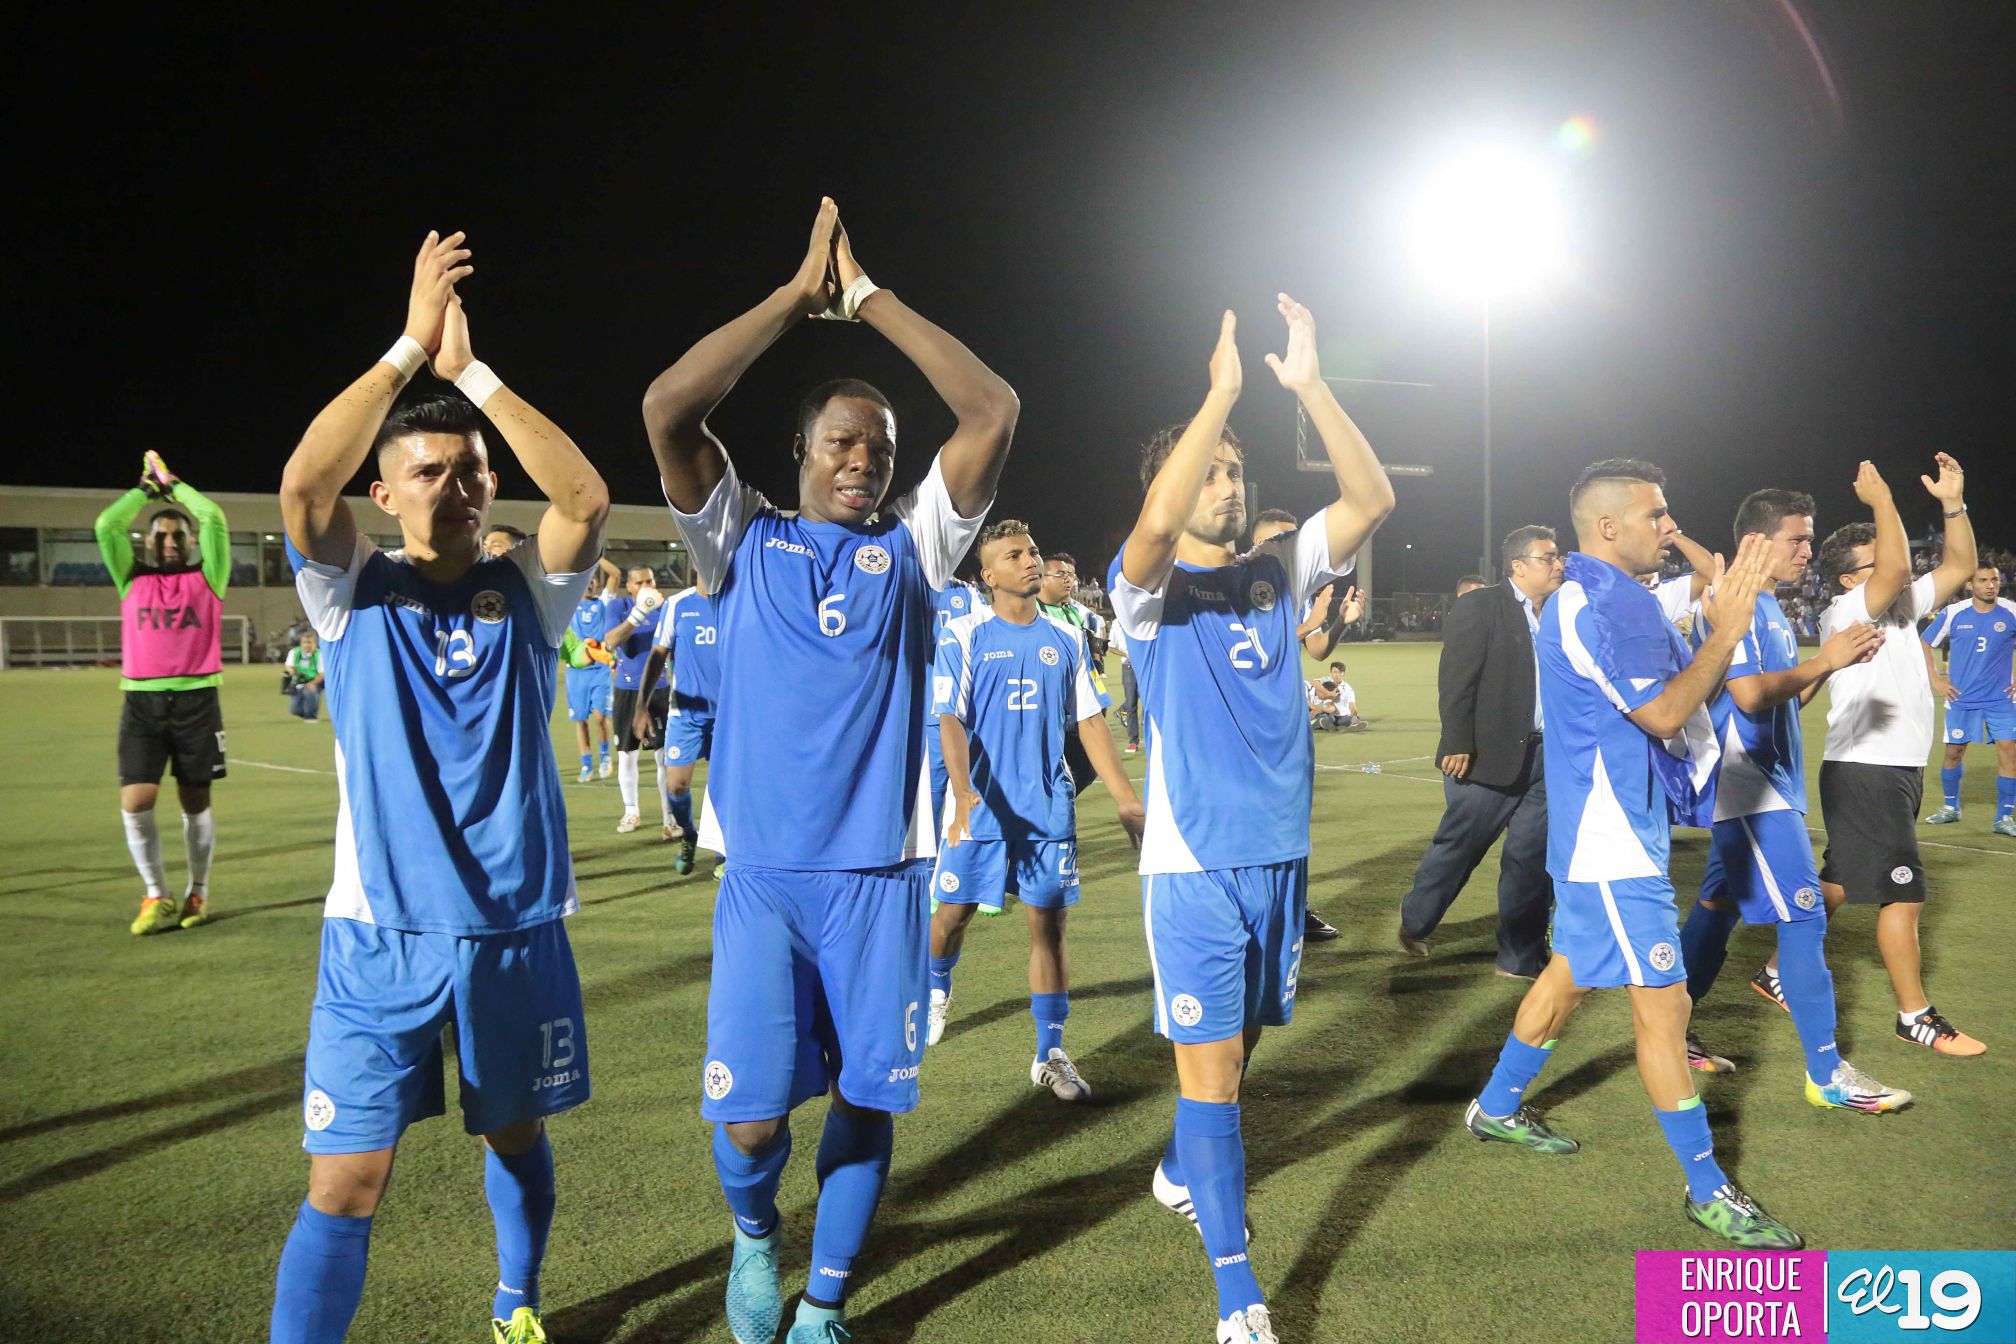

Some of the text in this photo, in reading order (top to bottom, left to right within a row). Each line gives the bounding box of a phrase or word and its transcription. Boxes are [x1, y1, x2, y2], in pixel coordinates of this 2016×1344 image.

[138, 606, 202, 630] FIFA
[818, 593, 846, 637] 6
[695, 625, 716, 645] 20
[1229, 623, 1269, 669] 21
[1976, 636, 1987, 653] 3
[435, 629, 477, 678] 13
[983, 650, 1015, 661] Joma
[1007, 678, 1039, 710] 22
[539, 1017, 576, 1069] 13
[905, 1001, 918, 1053] 6
[532, 1069, 581, 1092] Joma
